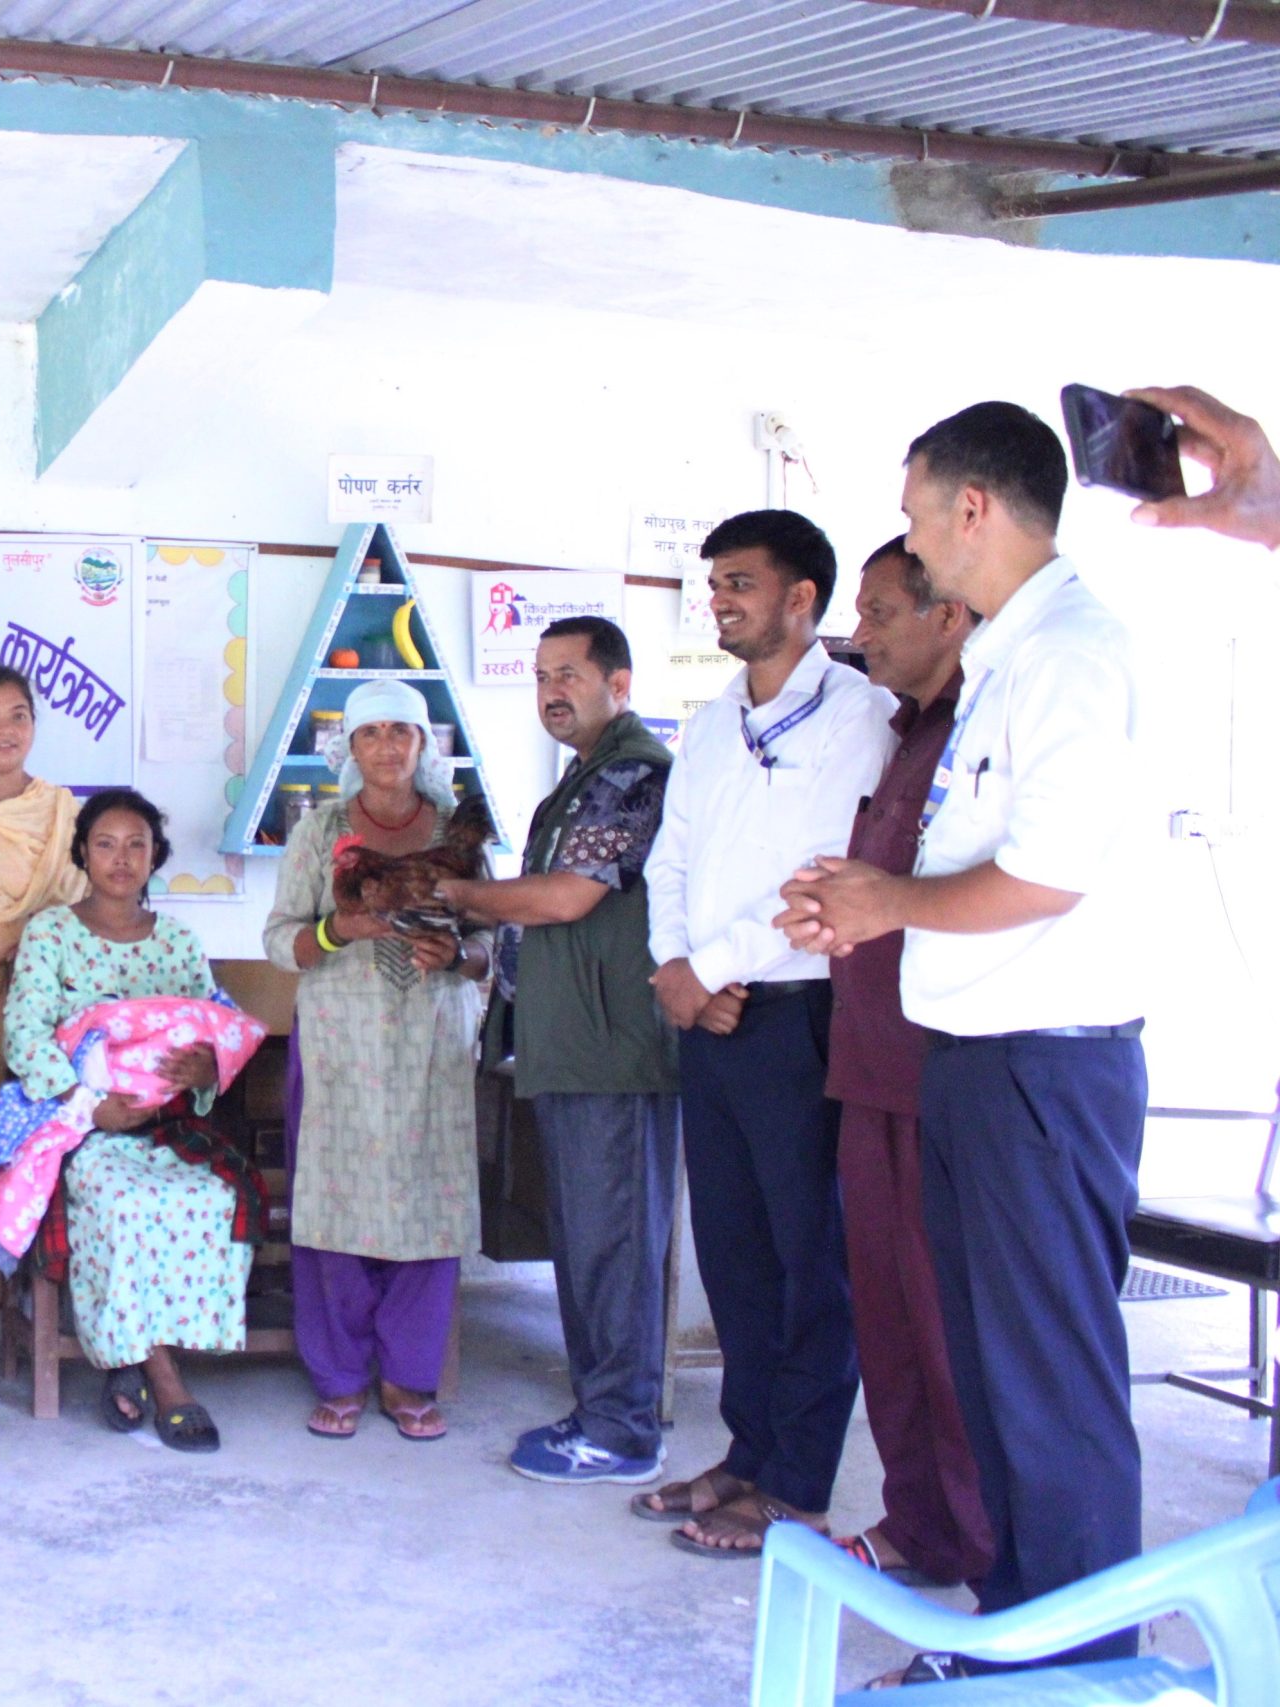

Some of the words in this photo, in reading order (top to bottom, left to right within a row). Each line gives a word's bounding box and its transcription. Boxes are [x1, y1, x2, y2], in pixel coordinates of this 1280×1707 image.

[338, 473, 378, 495] पोषण
[387, 474, 423, 495] कर्नर
[692, 519, 714, 531] तथा
[654, 540, 677, 553] नाम
[669, 655, 692, 665] समय
[481, 659, 524, 676] उरहरी
